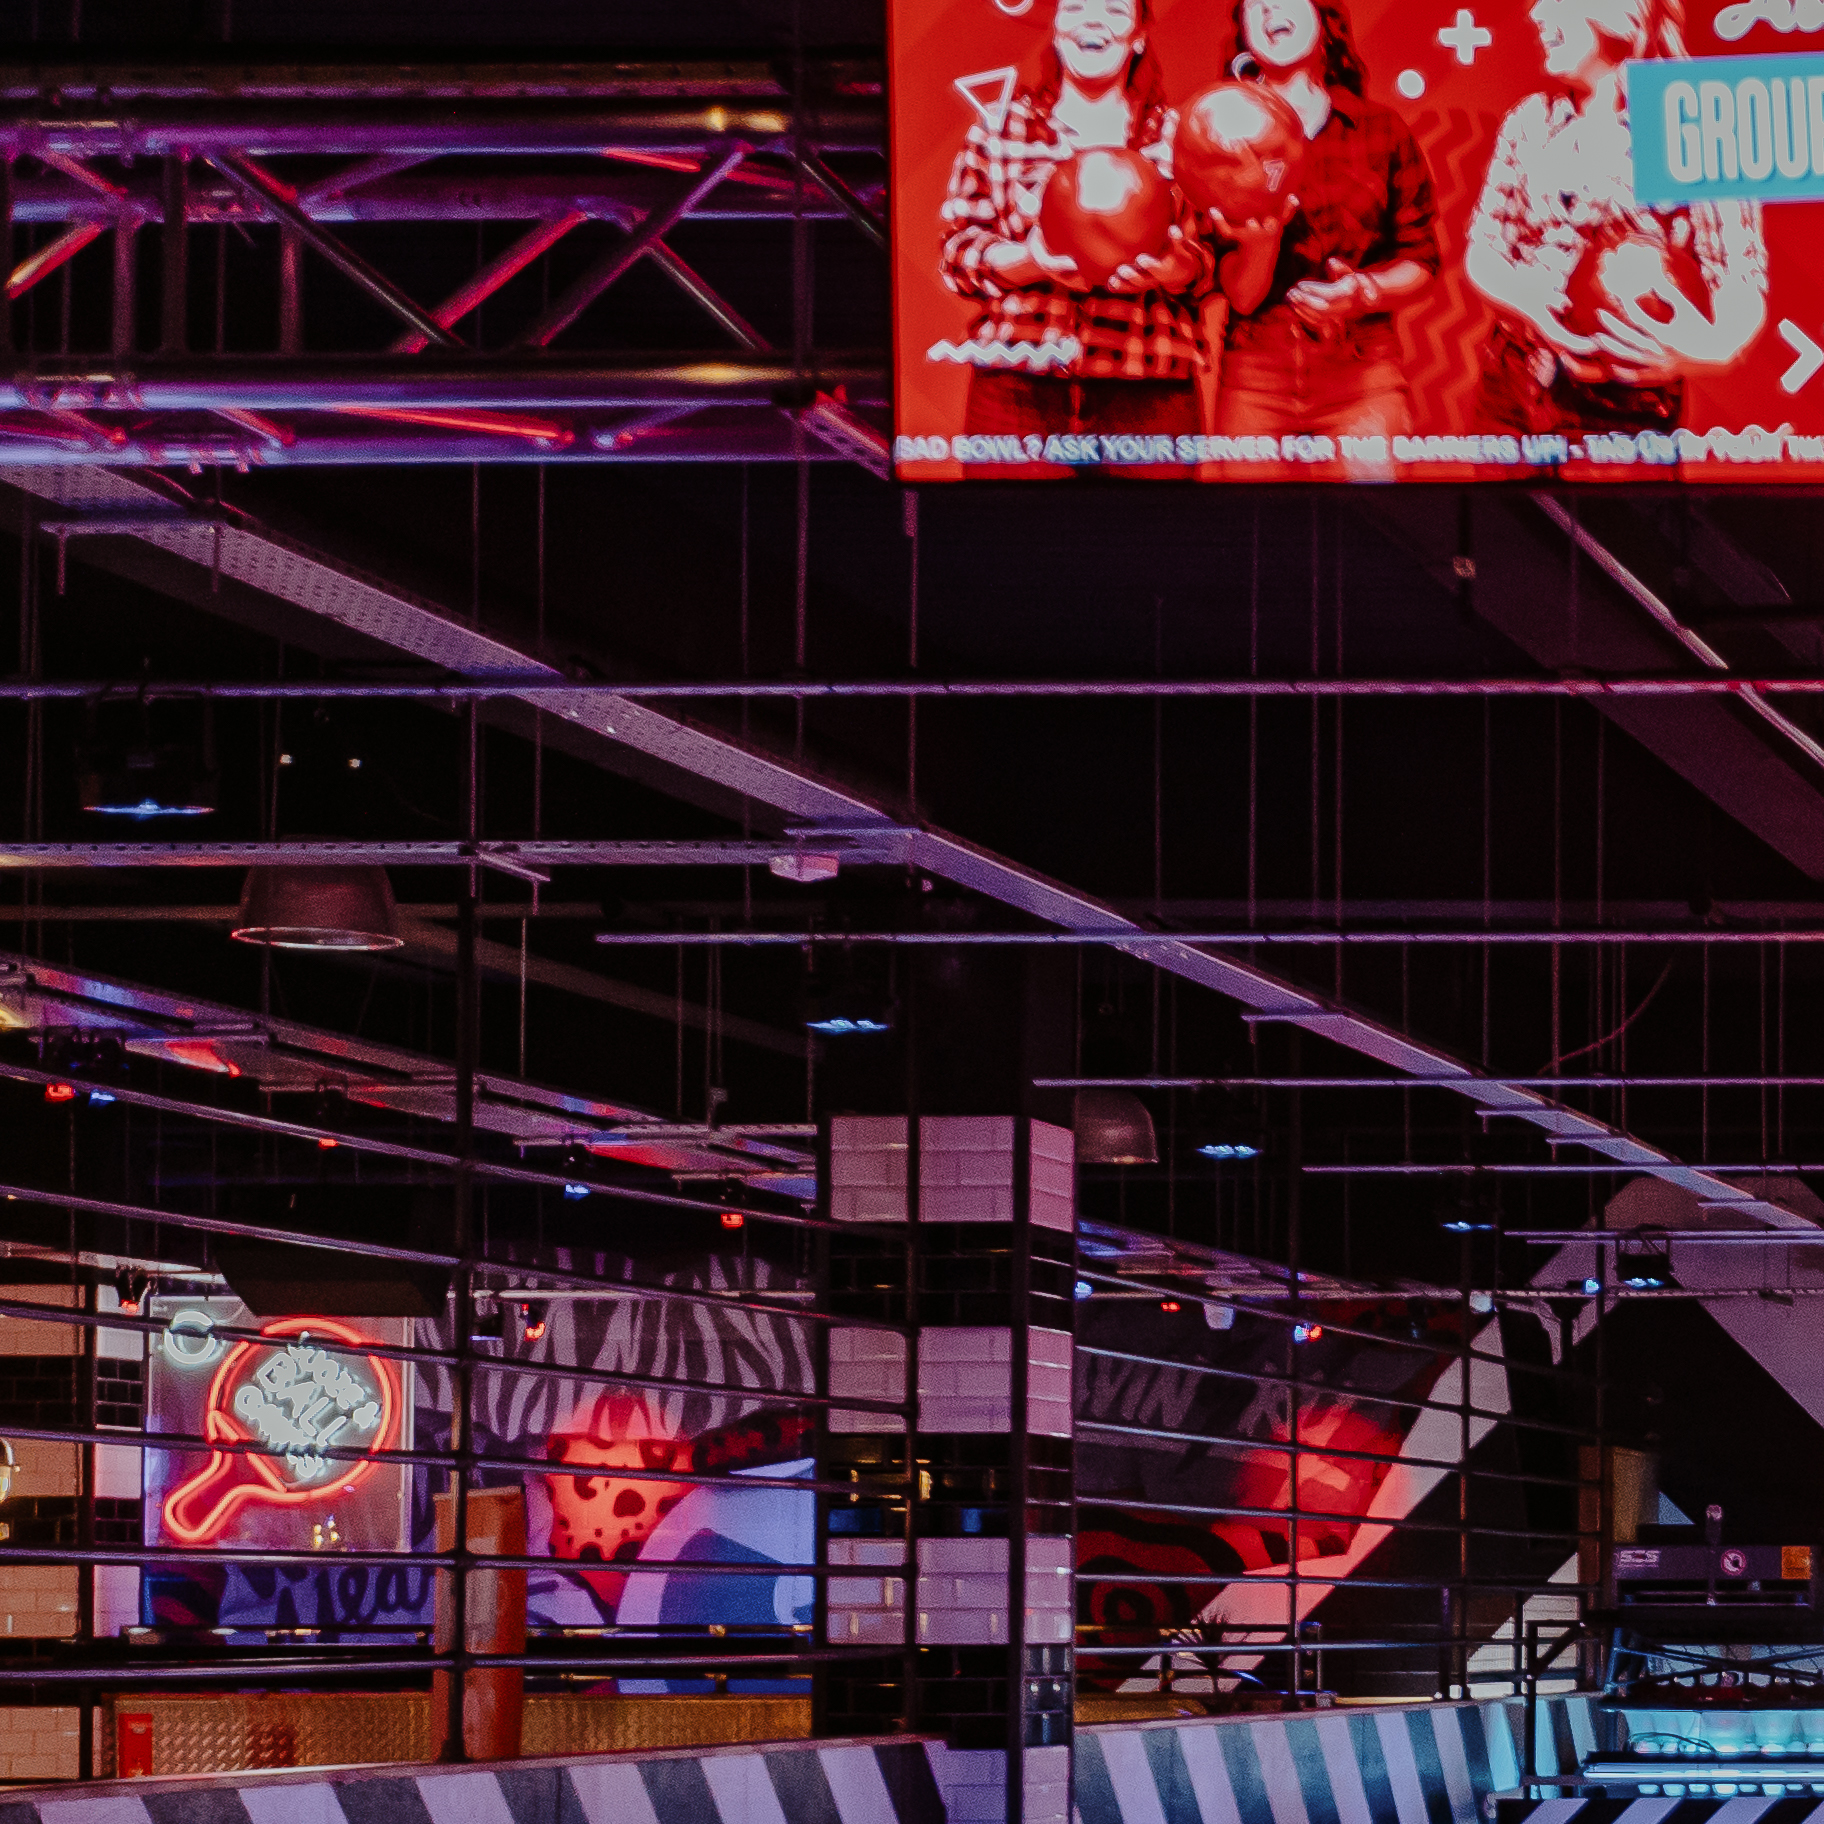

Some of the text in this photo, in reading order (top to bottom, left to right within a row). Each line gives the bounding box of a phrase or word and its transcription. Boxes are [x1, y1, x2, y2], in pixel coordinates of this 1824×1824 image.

[951, 433, 1043, 463] BOWL?
[1043, 433, 1100, 463] ASK
[1099, 433, 1175, 463] YOUR
